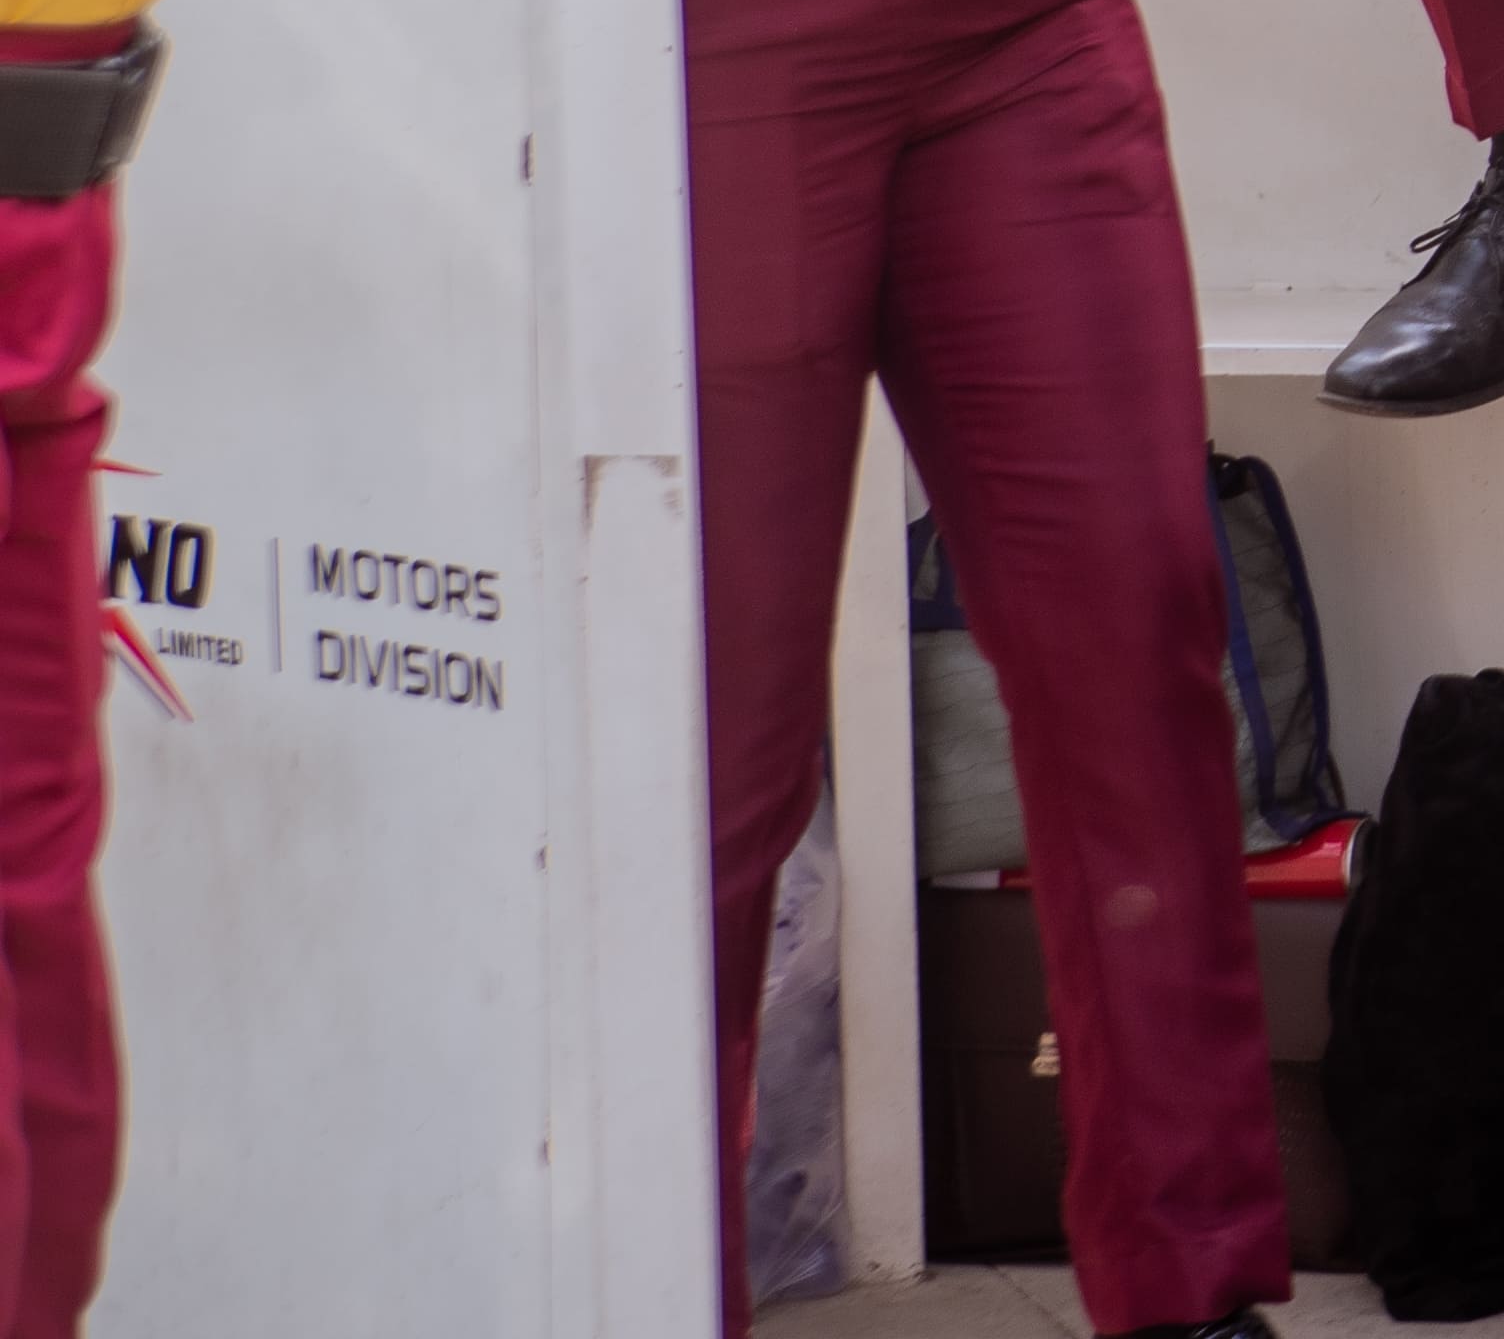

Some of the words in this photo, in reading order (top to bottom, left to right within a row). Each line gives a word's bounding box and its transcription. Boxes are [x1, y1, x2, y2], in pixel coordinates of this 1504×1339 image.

[109, 513, 212, 609] NO
[311, 542, 501, 622] MOTORS
[157, 626, 244, 666] LIMITED
[316, 629, 505, 711] DIVISION
